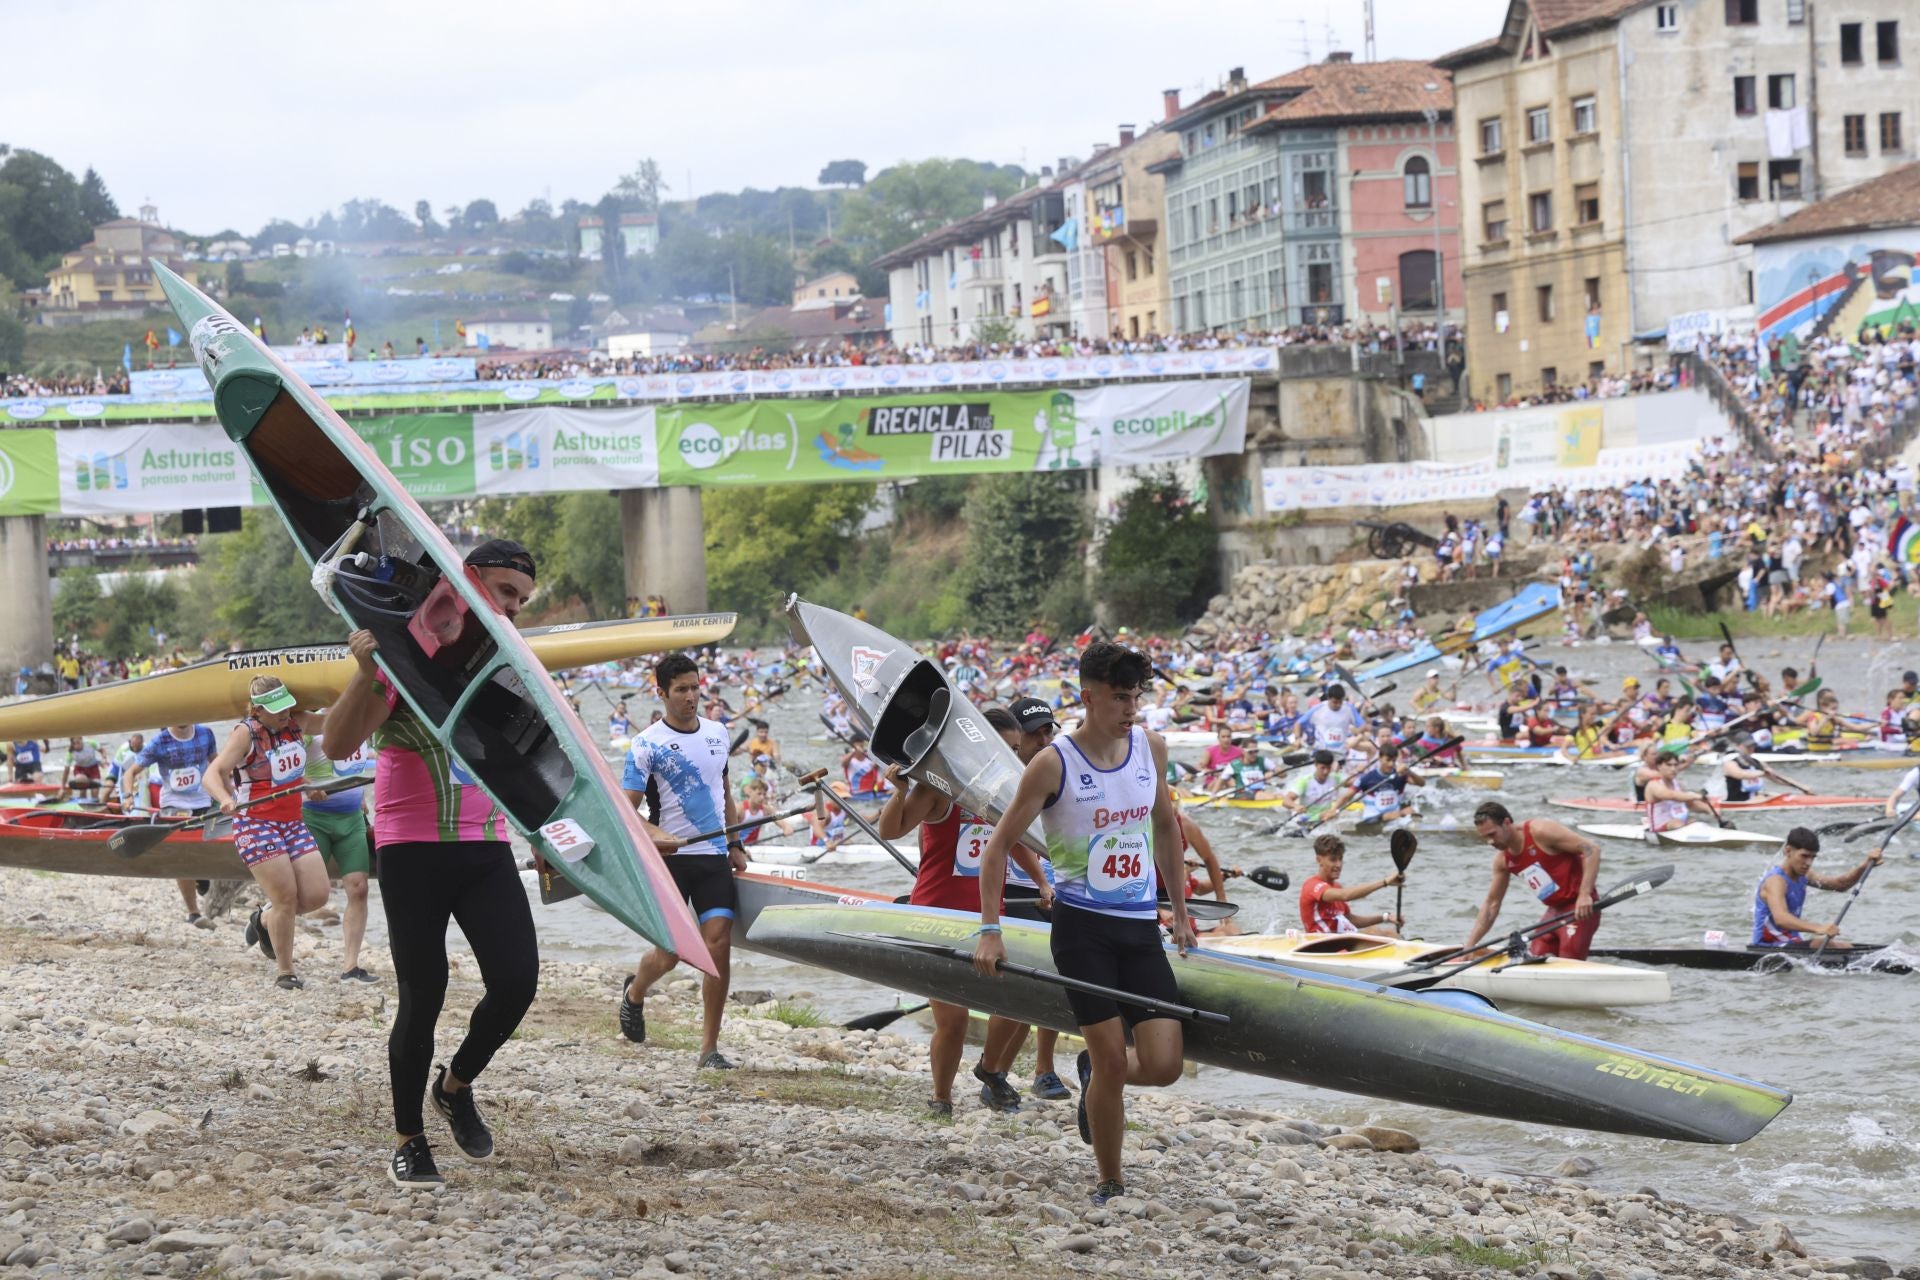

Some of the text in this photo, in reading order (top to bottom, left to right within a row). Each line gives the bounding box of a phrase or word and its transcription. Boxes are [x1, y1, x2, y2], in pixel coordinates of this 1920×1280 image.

[874, 405, 970, 434] RECICLA
[1113, 410, 1216, 436] ecopilas
[553, 430, 642, 450] Asturias
[679, 430, 787, 458] ecopilas
[939, 434, 1003, 459] PILAS
[141, 449, 235, 470] Asturias
[601, 453, 643, 464] natural
[192, 471, 236, 482] natural
[1022, 705, 1051, 716] adidas
[278, 753, 301, 772] 316
[176, 774, 195, 787] 207
[1093, 805, 1149, 829] Beyup
[545, 822, 577, 846] 416
[1119, 841, 1143, 850] Unicaja
[1102, 853, 1141, 878] 436
[1595, 1054, 1714, 1097] ZEDTECH
